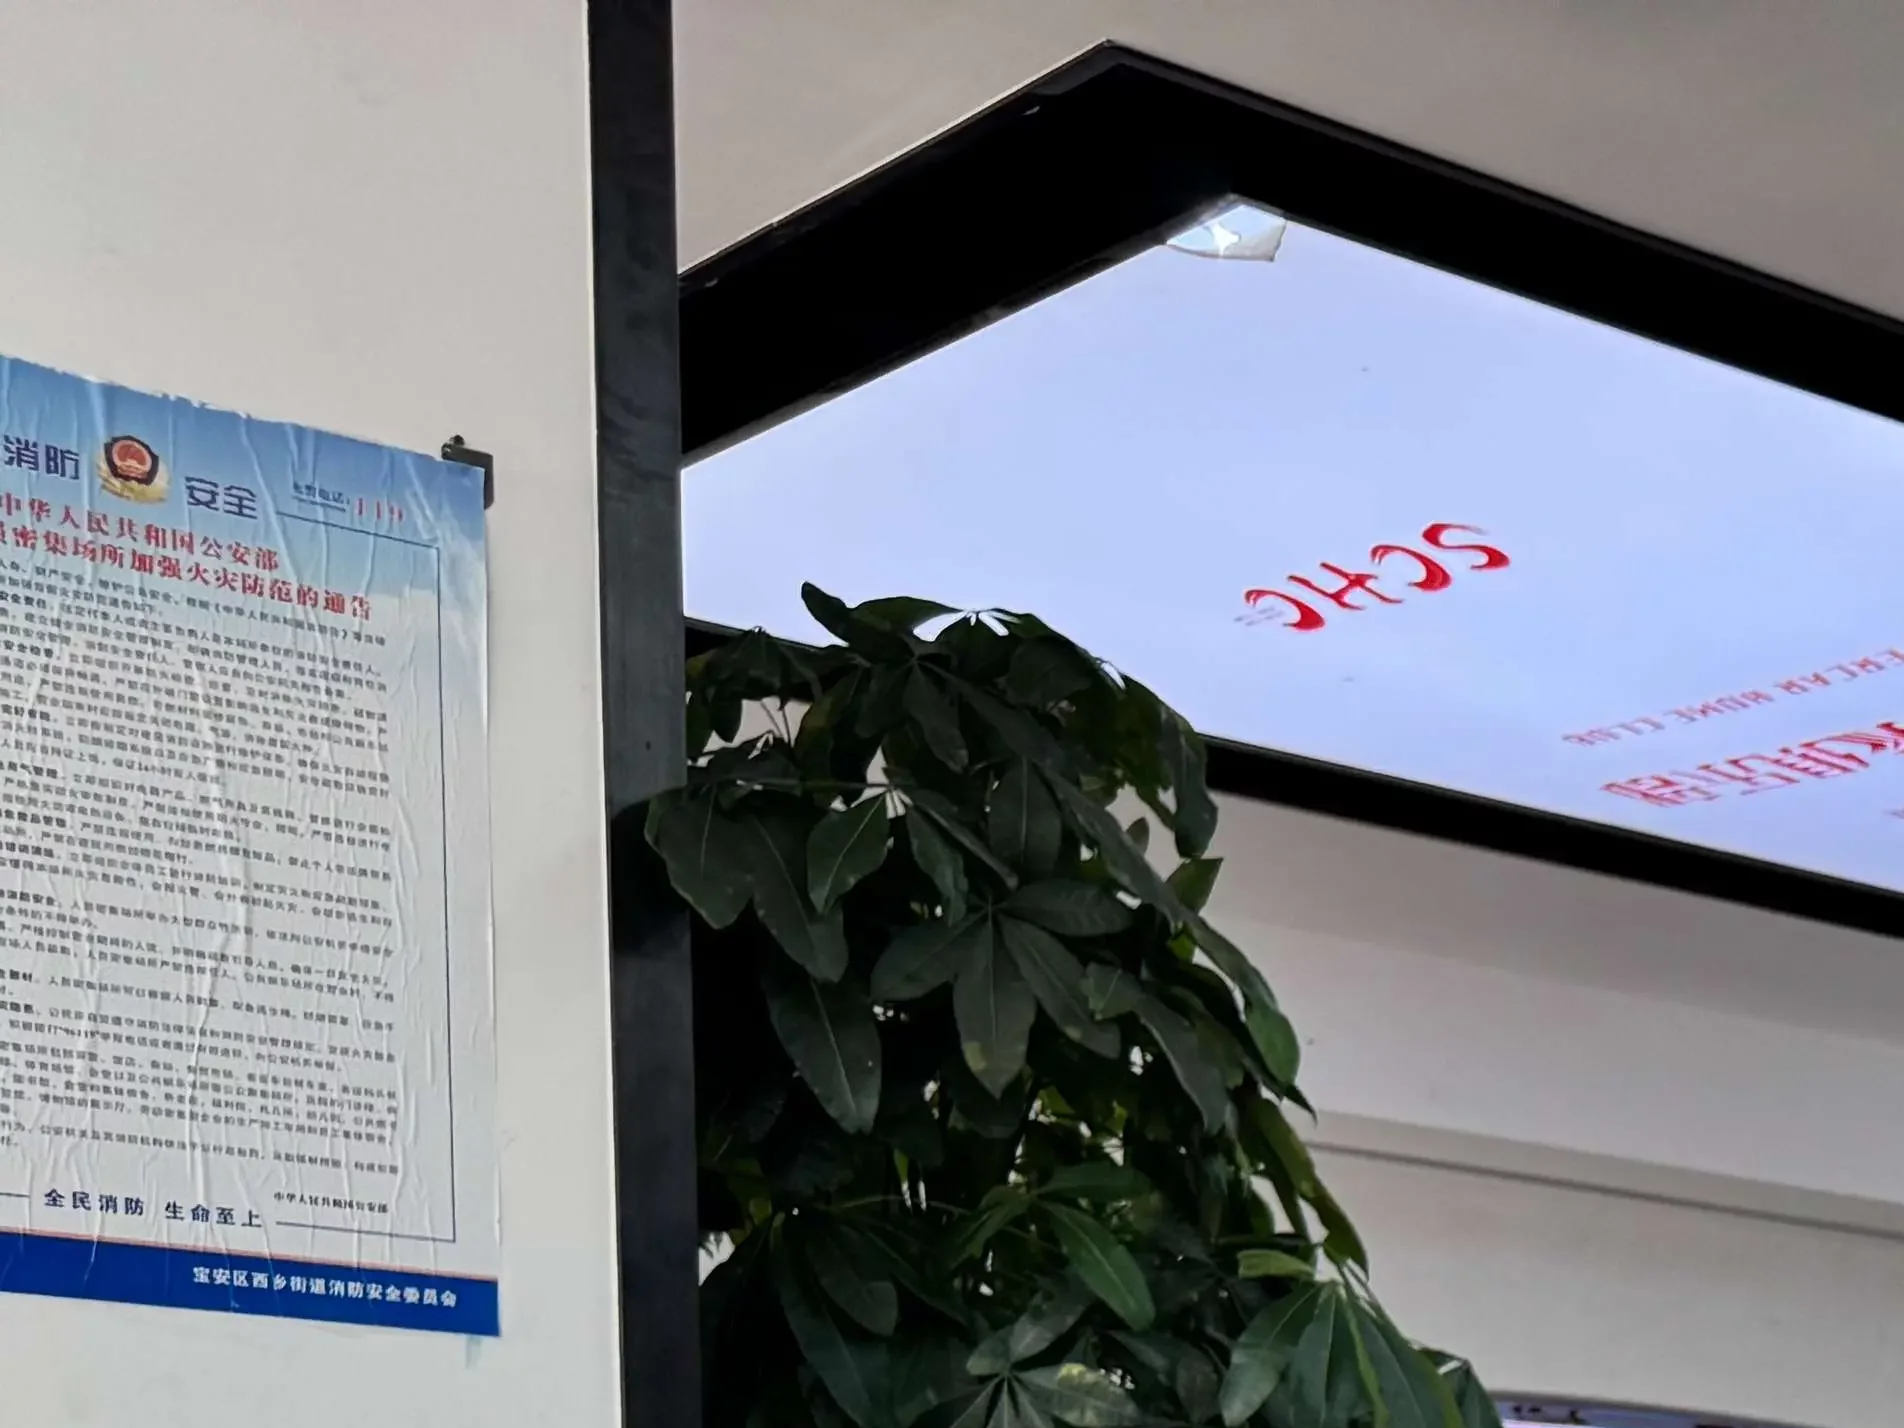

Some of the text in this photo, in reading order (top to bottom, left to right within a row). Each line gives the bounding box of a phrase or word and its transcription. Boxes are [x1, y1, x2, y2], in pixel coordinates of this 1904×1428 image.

[3, 434, 258, 519] 消防 安全
[0, 491, 279, 572] 中华人民共和国公安部
[0, 520, 371, 621] 密集场所加强火灾防范的通告
[45, 1188, 263, 1229] 全民消防 生命至上
[192, 1266, 458, 1309] 宝安区西乡街道消防安全委员会
